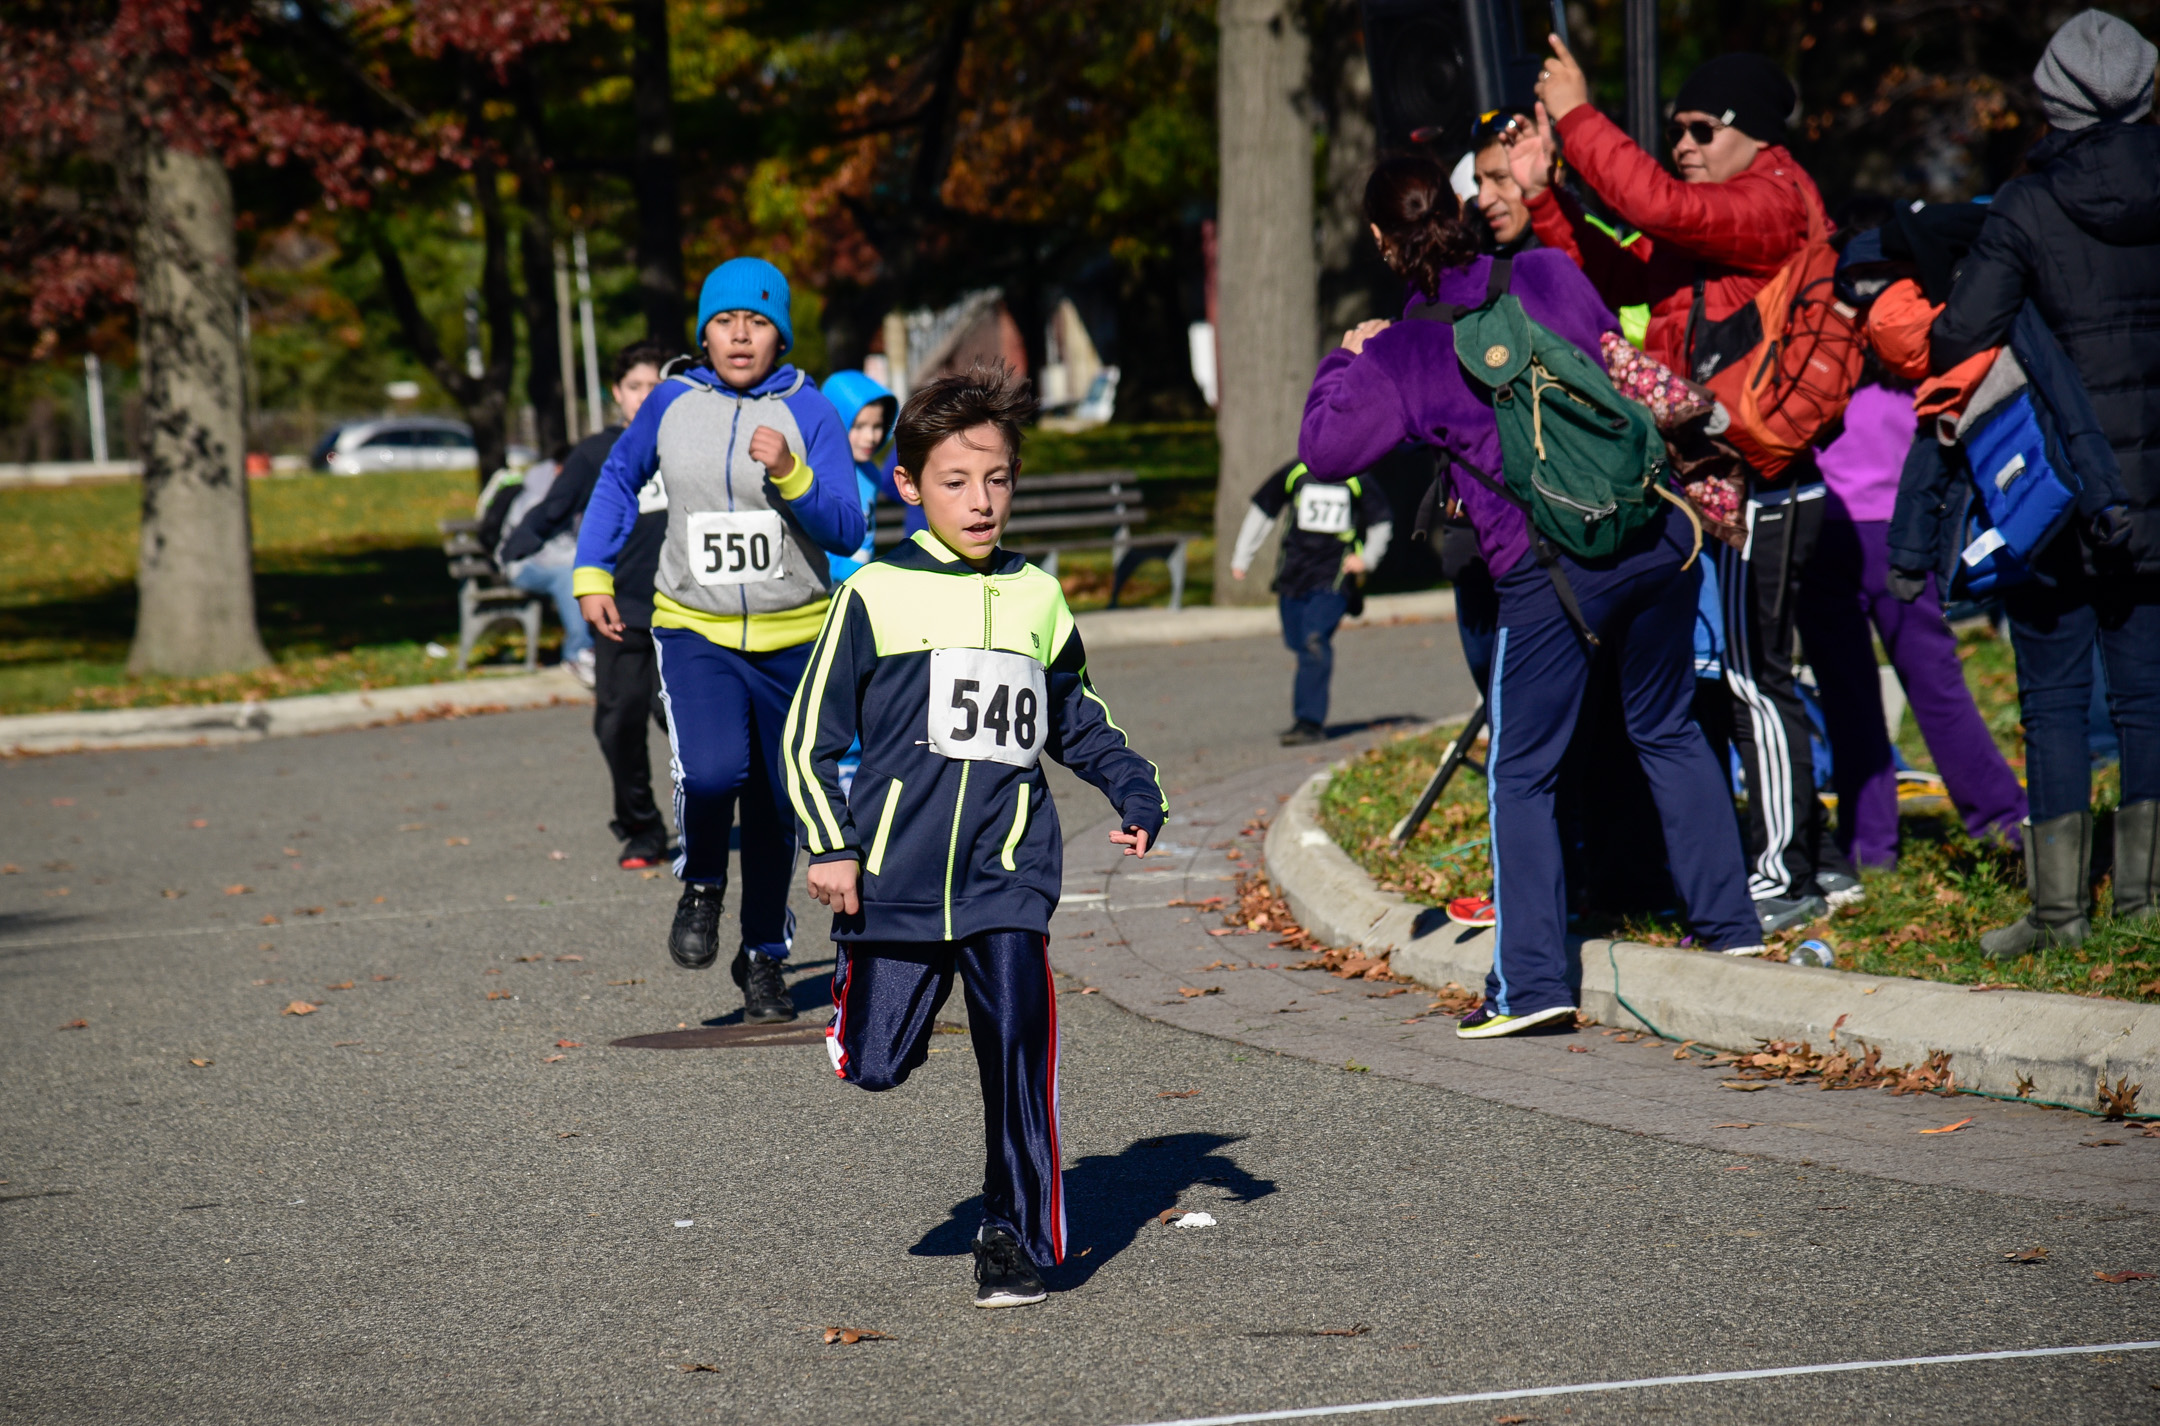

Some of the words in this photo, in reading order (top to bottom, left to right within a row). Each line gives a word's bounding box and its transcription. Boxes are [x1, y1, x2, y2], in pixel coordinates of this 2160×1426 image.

[1308, 499, 1348, 525] 577
[703, 532, 771, 574] 550
[949, 678, 1038, 750] 548
